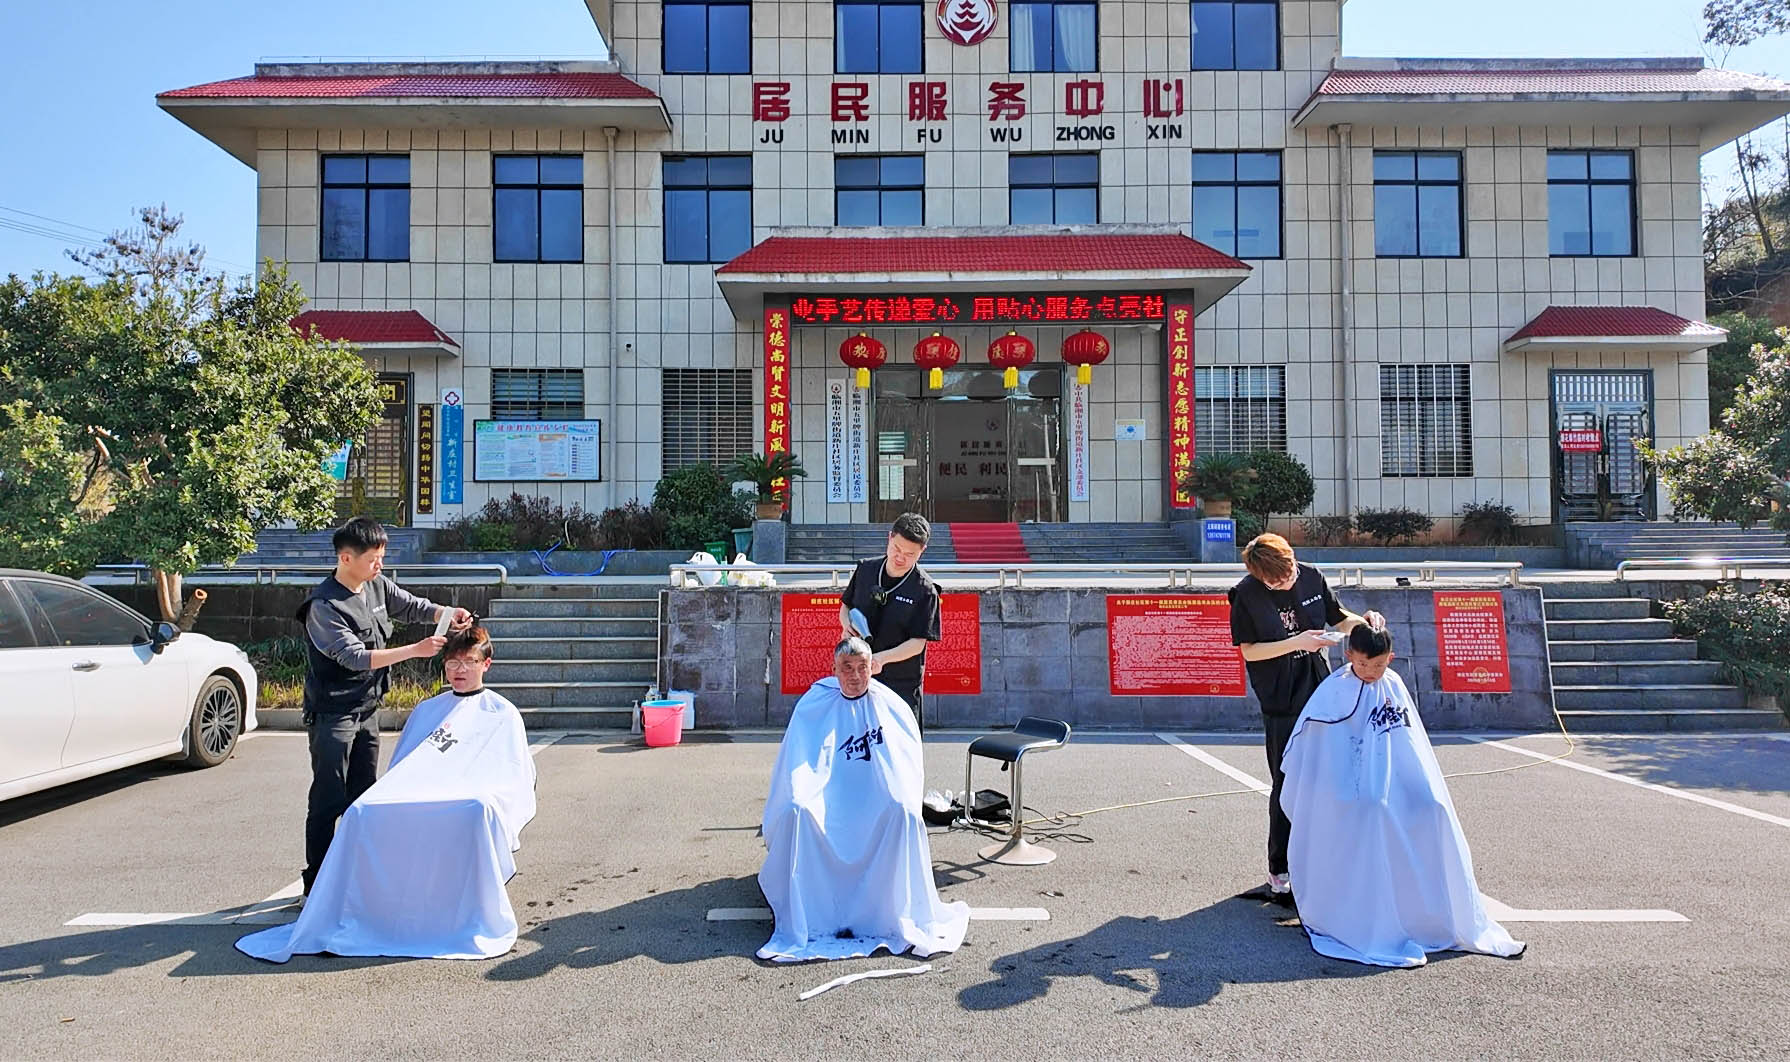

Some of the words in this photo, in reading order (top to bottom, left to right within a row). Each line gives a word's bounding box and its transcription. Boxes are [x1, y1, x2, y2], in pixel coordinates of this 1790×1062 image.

[752, 79, 1184, 122] 居民服务中心
[760, 129, 784, 144] JU
[831, 129, 869, 144] MIN
[917, 128, 942, 143] FU
[990, 127, 1022, 143] WU
[1056, 125, 1115, 141] ZHONG
[1148, 124, 1182, 140] XIN
